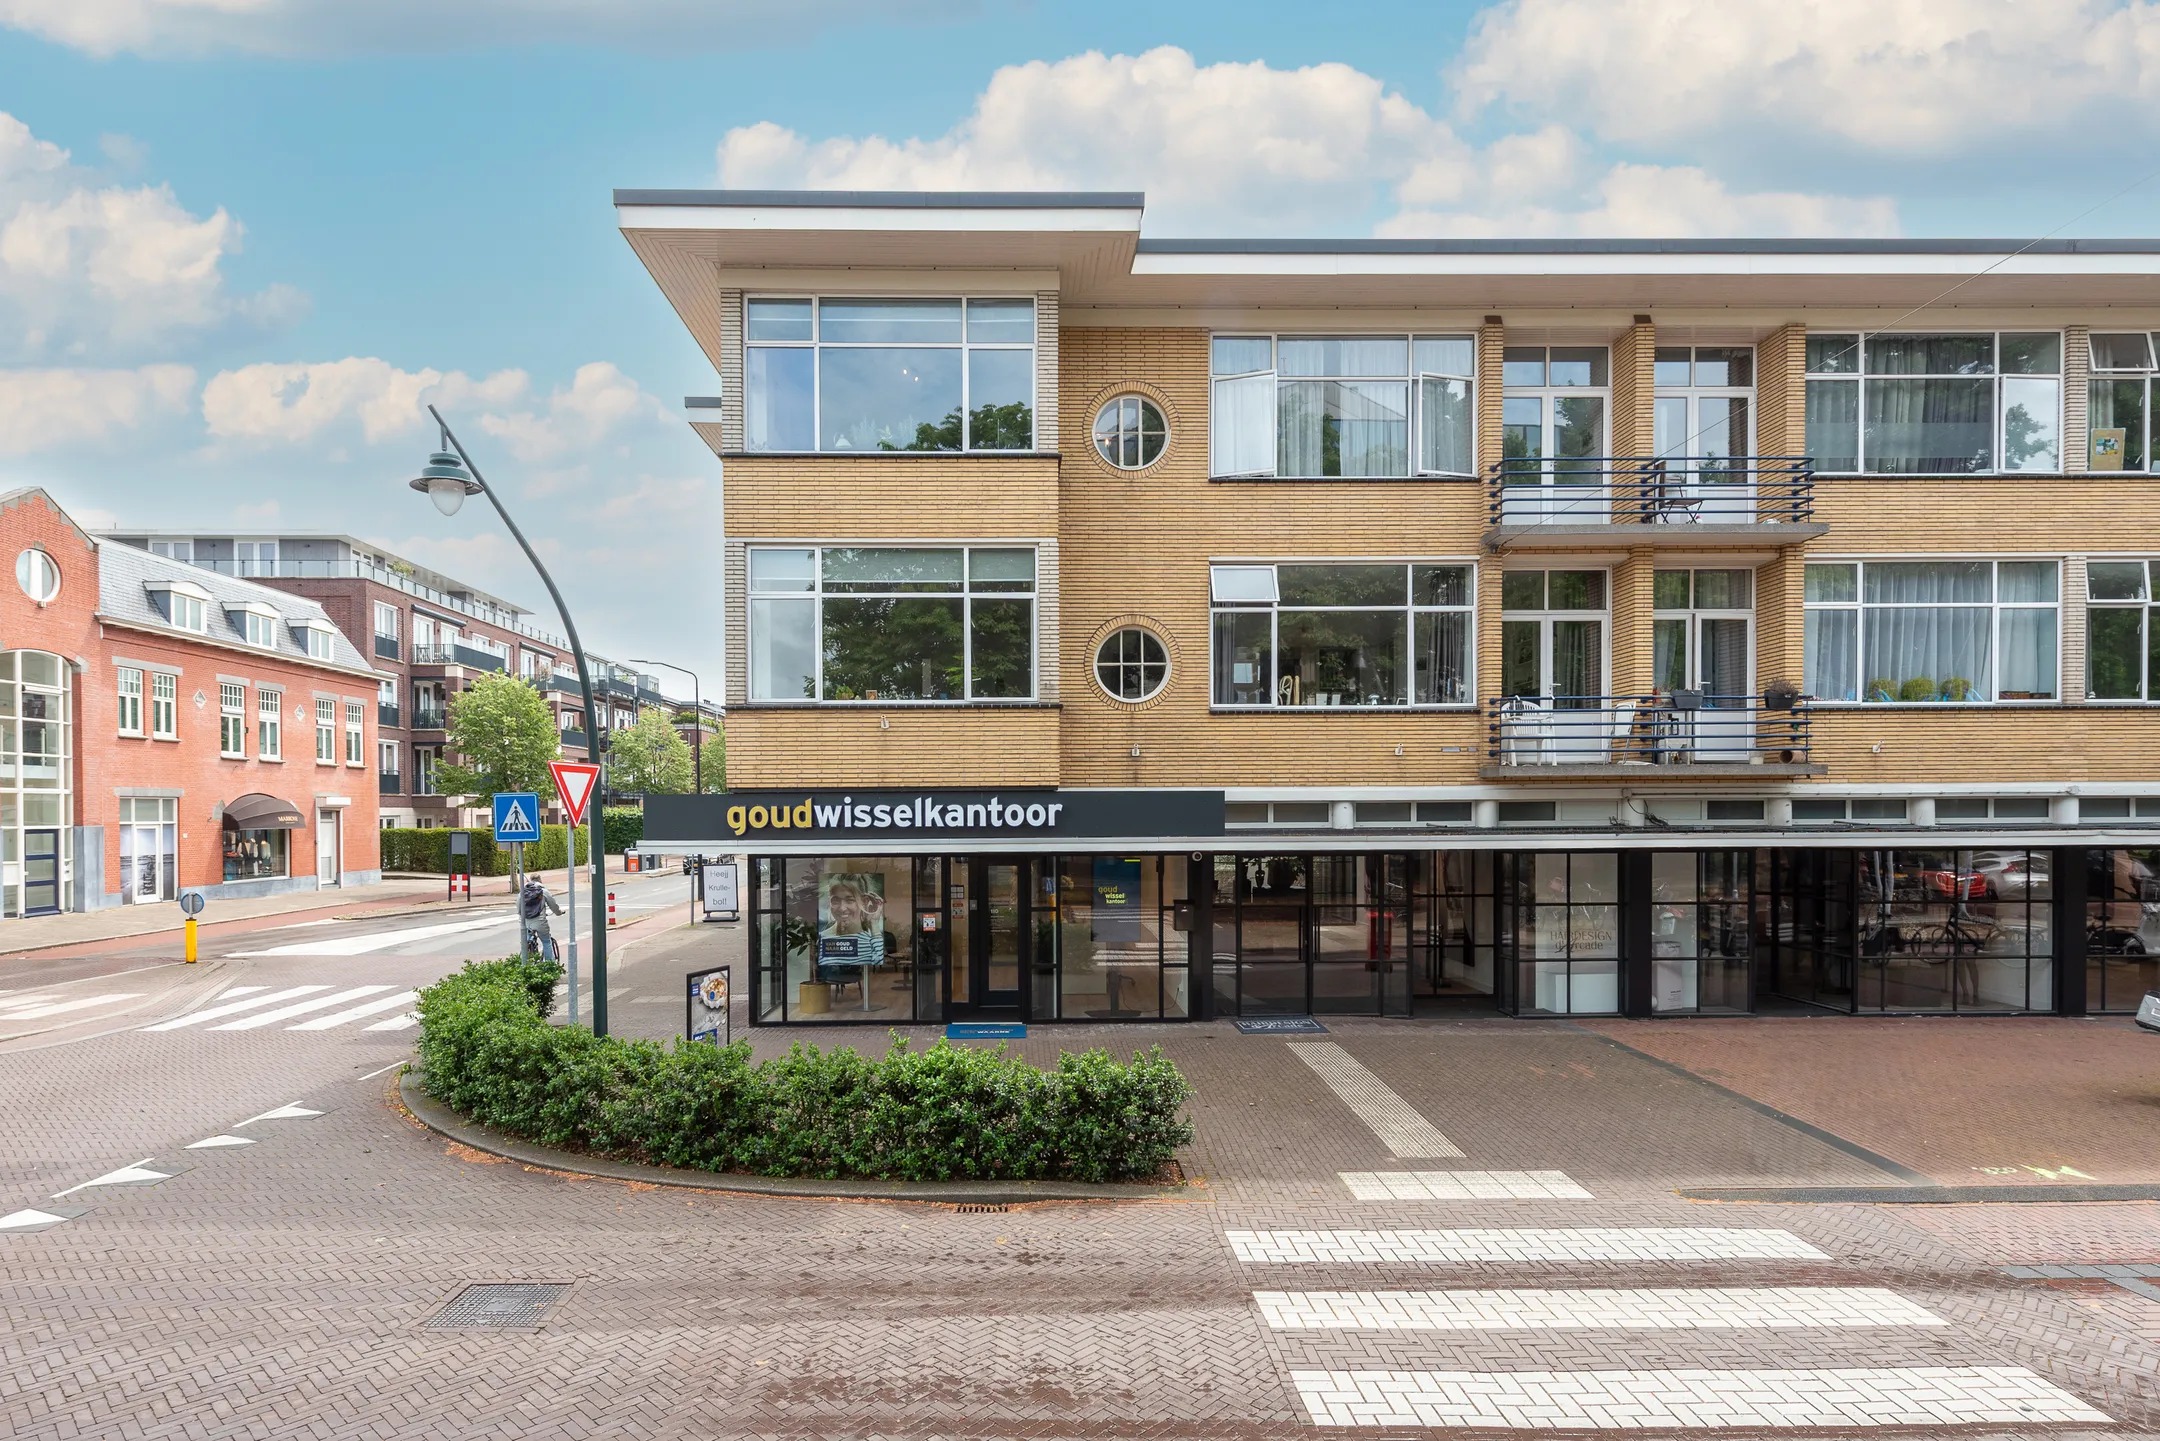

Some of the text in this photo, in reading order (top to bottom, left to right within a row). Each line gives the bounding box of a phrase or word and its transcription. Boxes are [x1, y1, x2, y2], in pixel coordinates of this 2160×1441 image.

[726, 796, 1063, 835] goudwisselkantoor
[1098, 886, 1118, 894] goud
[1550, 930, 1612, 941] HAIRDESIGN
